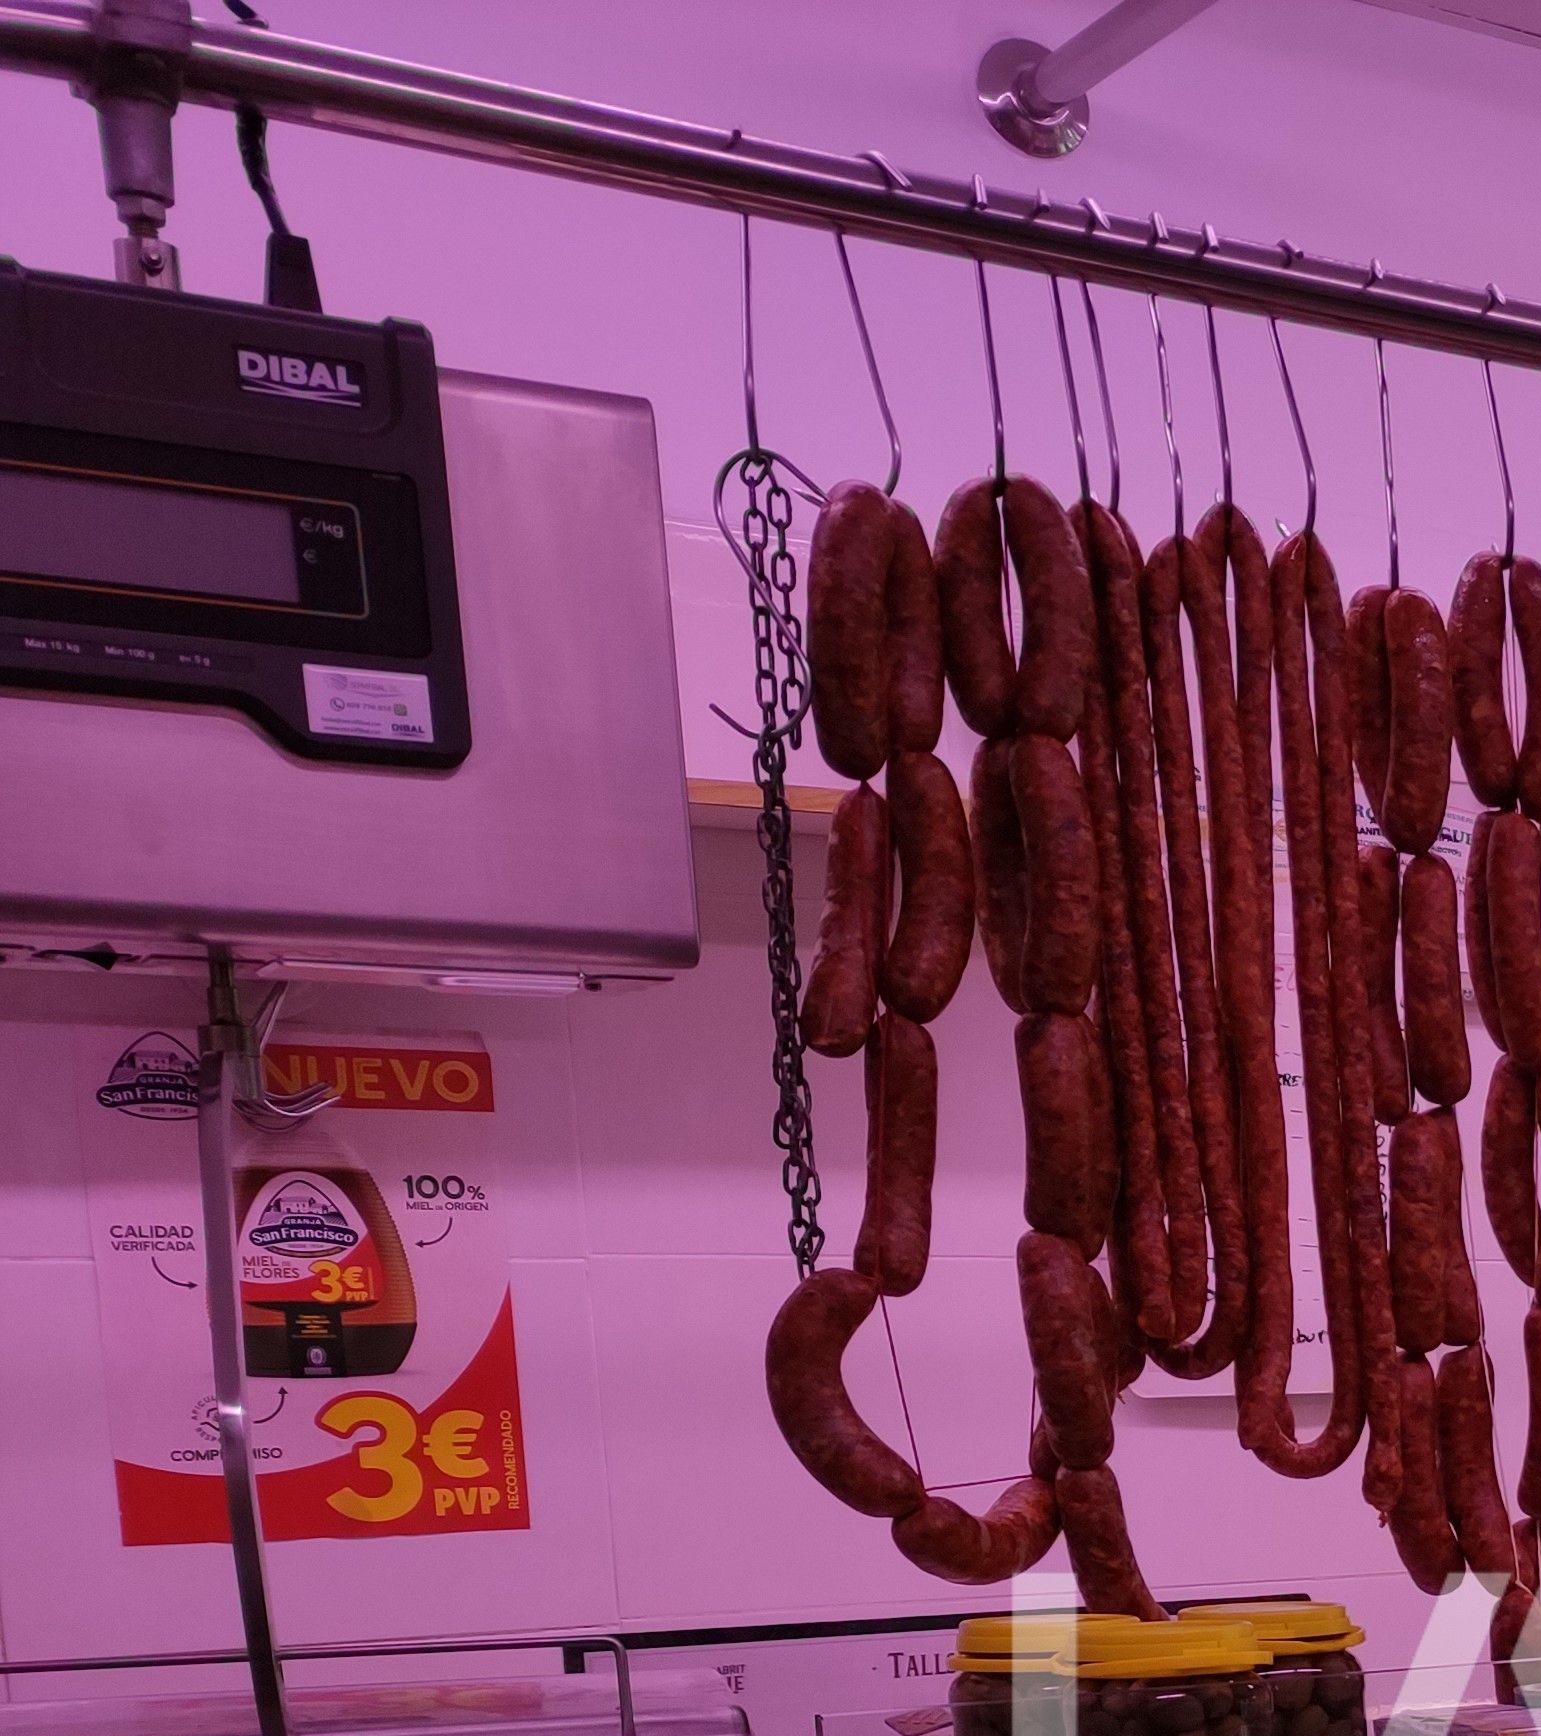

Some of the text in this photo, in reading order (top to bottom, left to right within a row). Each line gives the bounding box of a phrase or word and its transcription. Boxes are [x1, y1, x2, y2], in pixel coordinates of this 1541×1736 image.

[237, 349, 361, 394] DIBAL
[139, 1076, 184, 1086] GRANJA
[261, 1054, 480, 1103] NUEVO
[101, 1086, 200, 1104] San Francis
[402, 1175, 486, 1200] 100%
[406, 1201, 434, 1211] MIEL
[445, 1201, 489, 1211] ORIGEN
[284, 1217, 322, 1226] GRANJA
[109, 1225, 194, 1239] CALIDAD
[252, 1227, 355, 1244] San Francisco
[111, 1241, 196, 1252] VERIFICADA
[242, 1255, 278, 1267] MIEL
[243, 1267, 300, 1279] FLORES
[346, 1291, 369, 1302] PVP
[170, 1447, 283, 1462] COMPISO
[500, 1409, 521, 1511] RECOMENDADO
[434, 1486, 500, 1517] PVP
